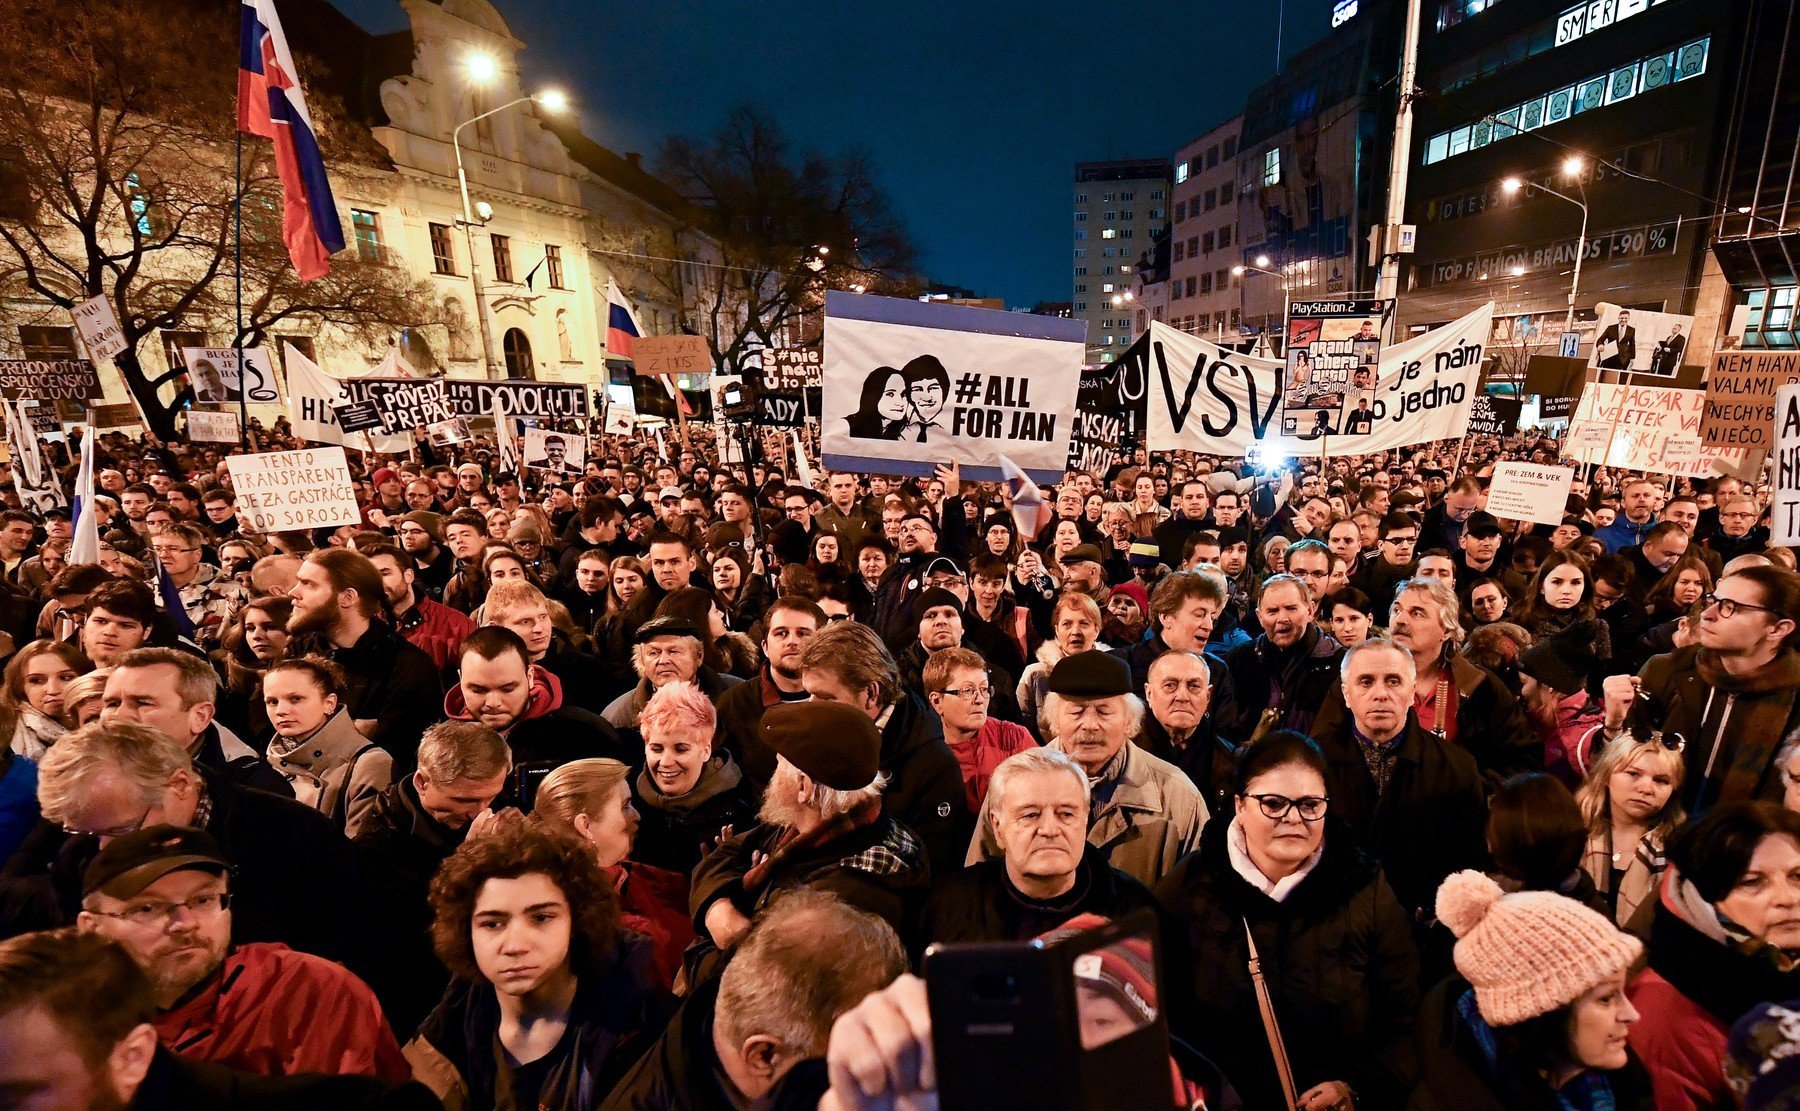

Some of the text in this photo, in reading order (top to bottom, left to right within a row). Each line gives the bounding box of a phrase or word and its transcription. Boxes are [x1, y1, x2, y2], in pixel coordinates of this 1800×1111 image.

[1560, 0, 1613, 42] SMER
[1438, 264, 1463, 282] TOP
[1465, 251, 1527, 276] FASHION
[1532, 238, 1602, 268] BRANDS
[1309, 339, 1355, 355] grand
[222, 360, 235, 369] JE
[1314, 355, 1359, 369] theft
[1389, 338, 1482, 391] je nám
[1717, 354, 1800, 373] NEM HIÁN
[16, 387, 88, 400] ZMLUVU
[451, 384, 473, 398] IM
[781, 376, 799, 389] to
[1154, 341, 1322, 440] VŠV
[1714, 376, 1777, 398] VALAMI,
[382, 379, 450, 412] POVEDZ
[450, 399, 474, 413] TO
[1392, 379, 1466, 422] jedno
[952, 406, 1057, 442] FOR JAN
[1598, 405, 1667, 428] VELETEK
[1706, 425, 1767, 446] NIEČO,
[259, 452, 314, 469] TENTO
[234, 467, 345, 489] TRANSPARENT
[1504, 469, 1520, 477] PRE:
[1520, 470, 1535, 478] ZEM
[1545, 474, 1561, 482] VEK
[239, 482, 355, 509] JE ZA GASTRÁČE
[254, 507, 353, 529] OD SOROSA
